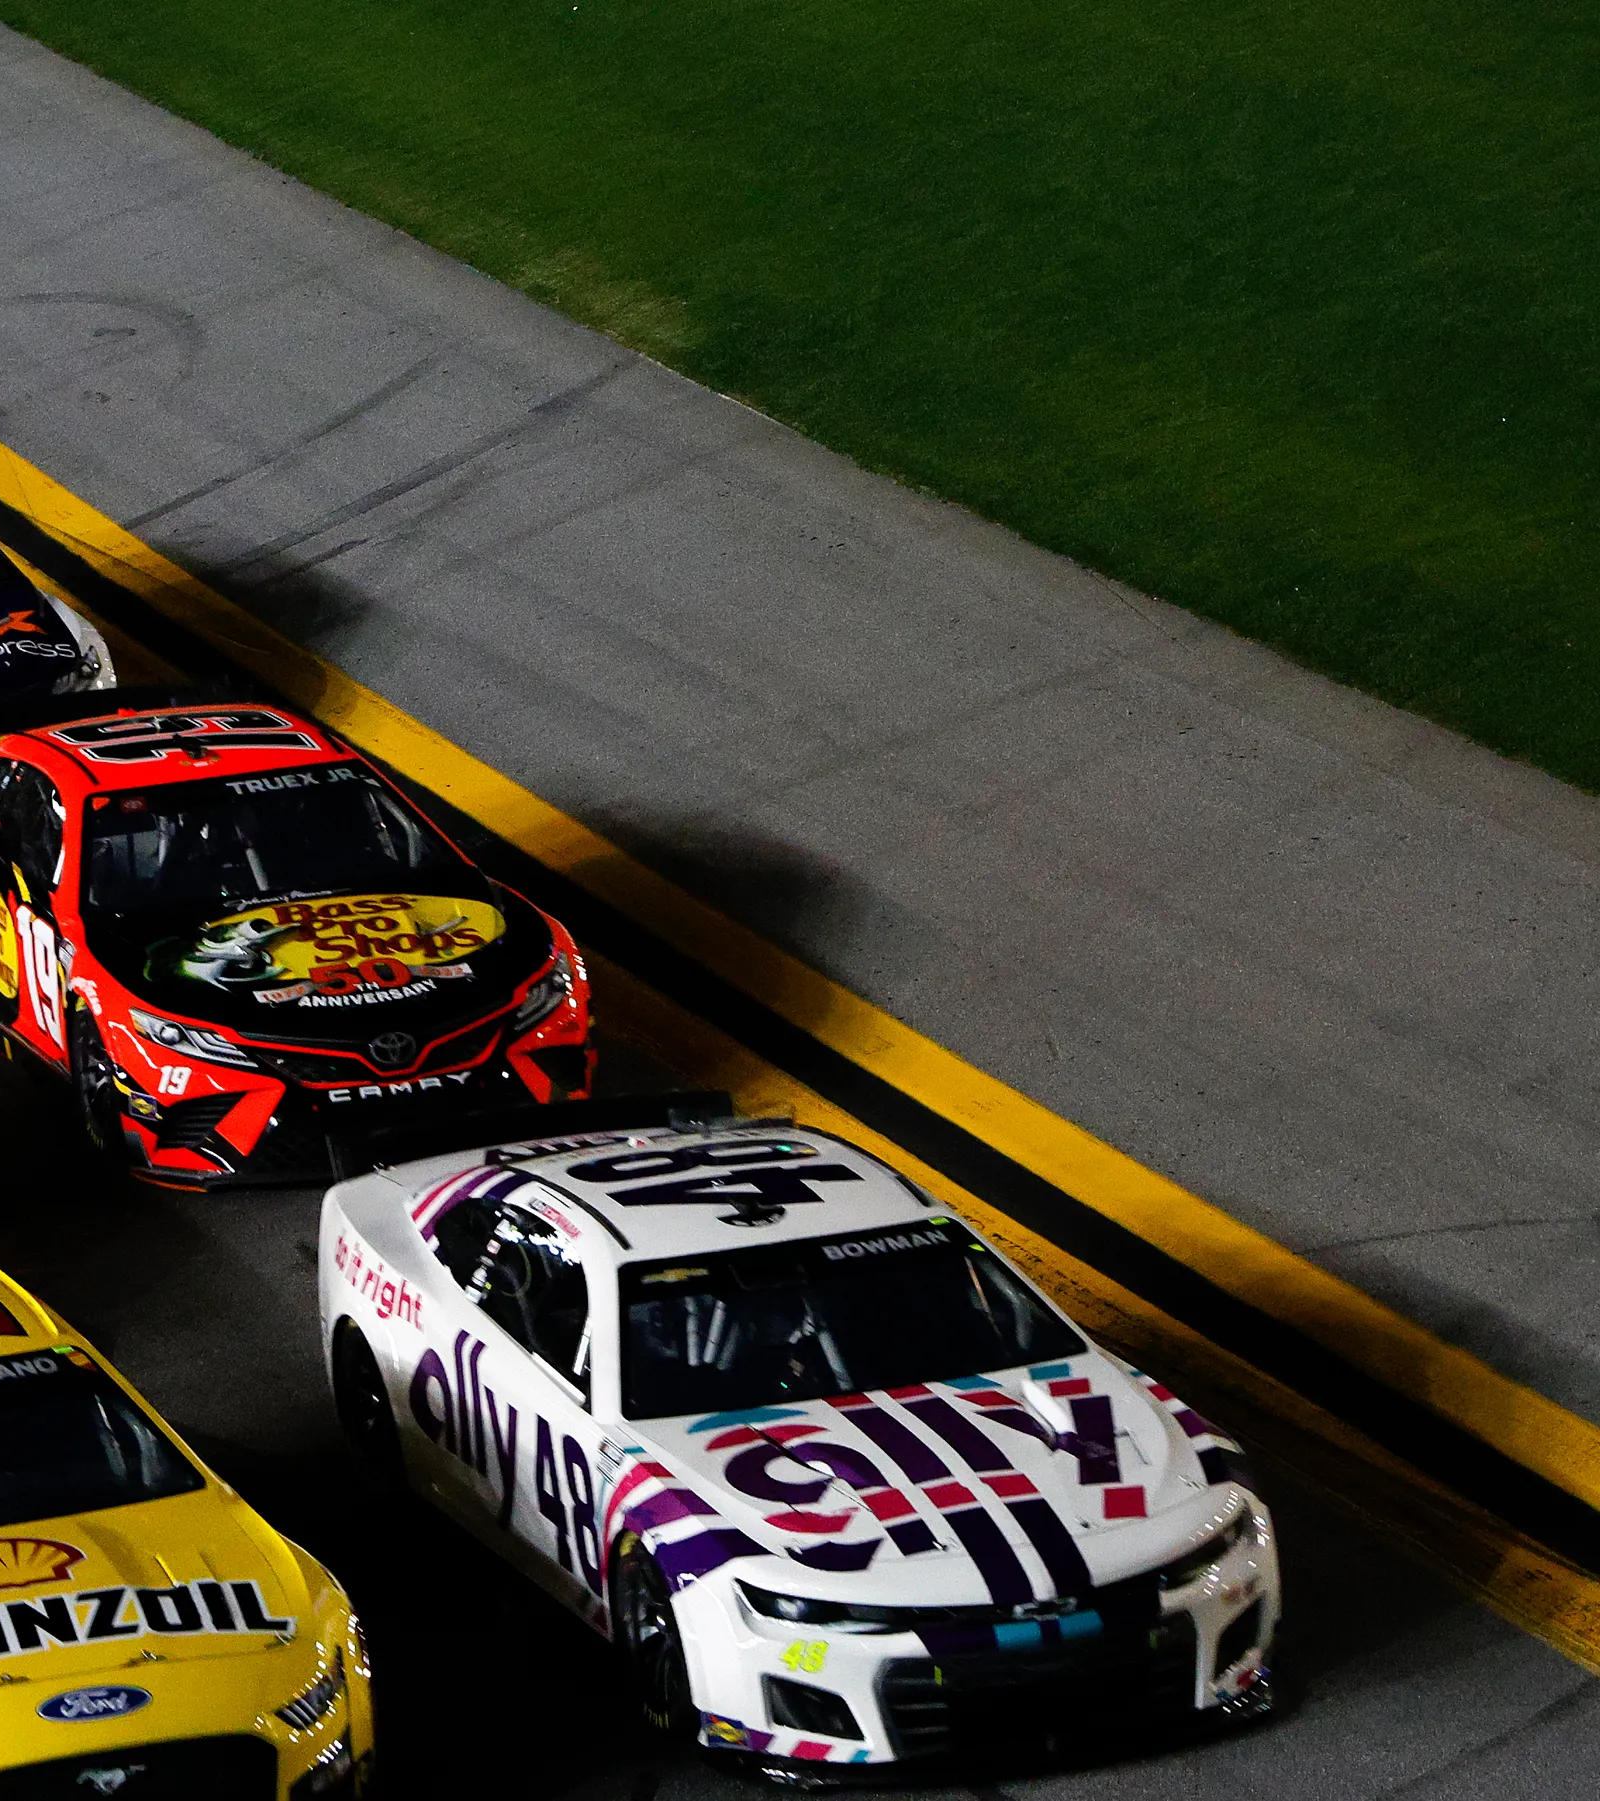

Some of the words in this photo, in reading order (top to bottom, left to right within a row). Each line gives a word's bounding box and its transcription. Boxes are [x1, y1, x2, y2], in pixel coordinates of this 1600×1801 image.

[225, 771, 320, 795] TRUEX
[272, 895, 413, 926] Bass
[299, 914, 401, 942] Pro
[312, 927, 488, 964] Shops
[16, 904, 66, 1052] 19
[309, 957, 412, 996] 50
[352, 981, 380, 992] TH
[298, 978, 438, 1008] ANNIVERSARY
[157, 1065, 193, 1096] 19
[328, 1070, 473, 1103] CAMRY
[821, 1229, 951, 1261] BOWMAN
[409, 1329, 519, 1534] ally
[534, 1412, 604, 1600] 48
[779, 1639, 831, 1674] 48
[60, 1690, 129, 1718] Ford
